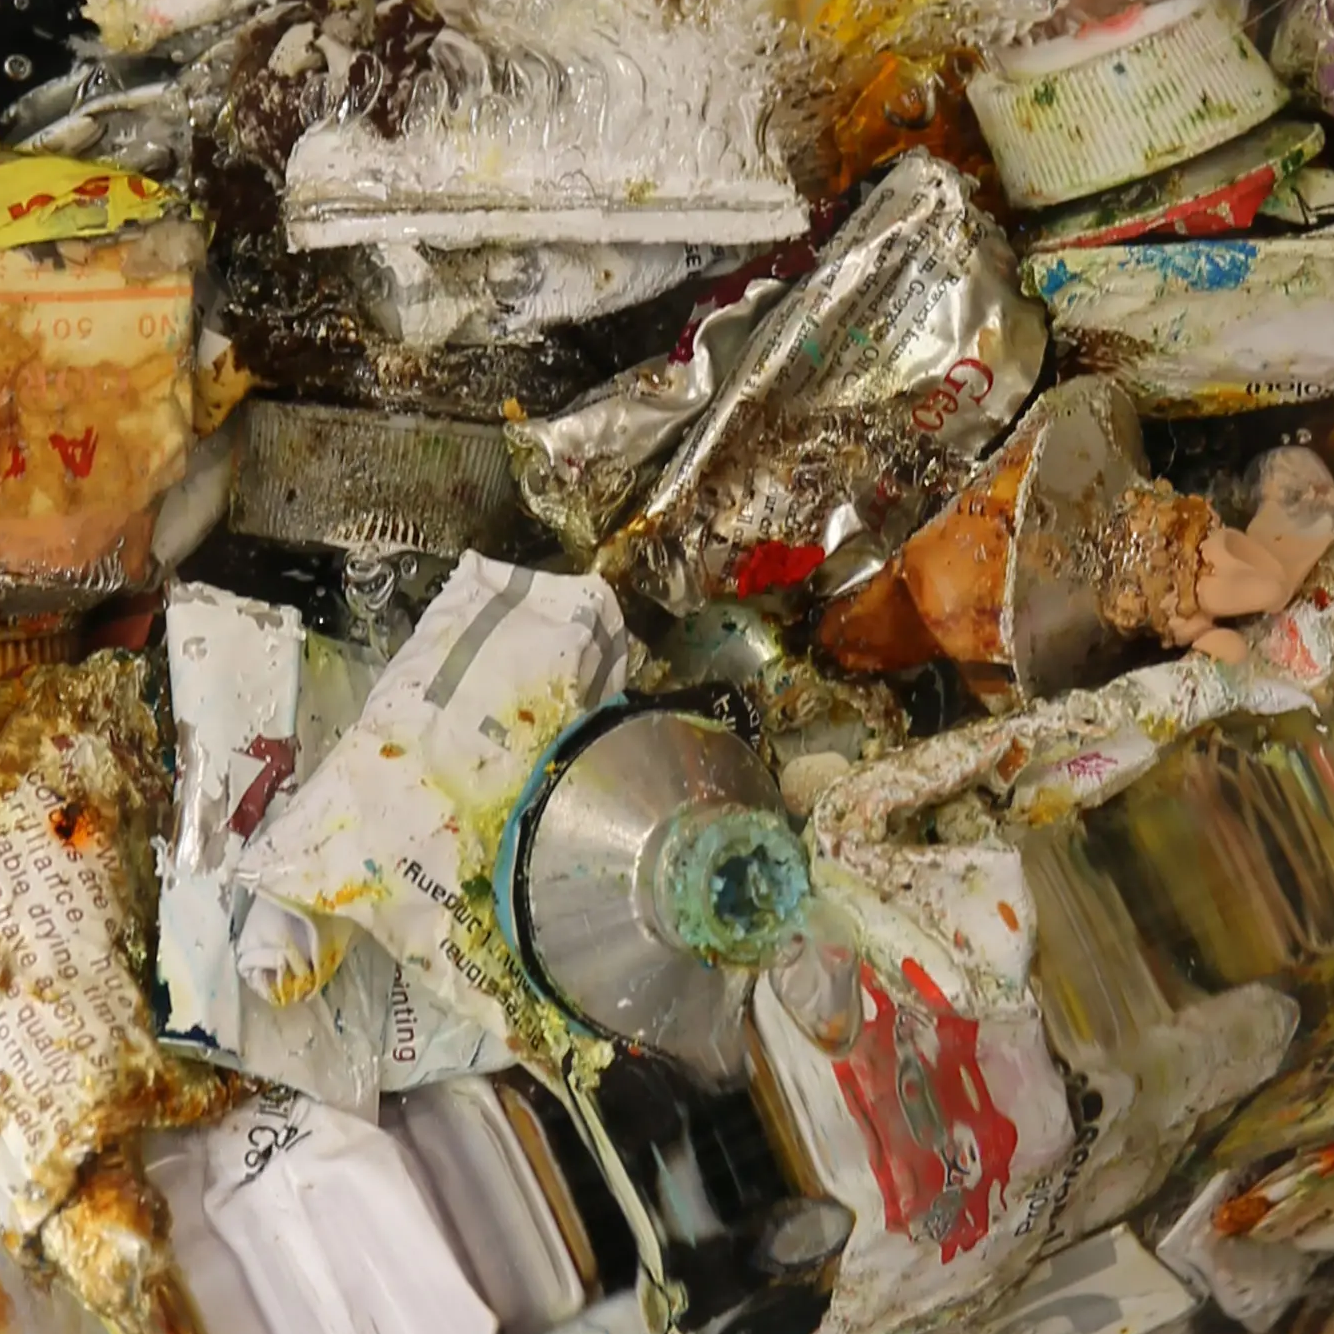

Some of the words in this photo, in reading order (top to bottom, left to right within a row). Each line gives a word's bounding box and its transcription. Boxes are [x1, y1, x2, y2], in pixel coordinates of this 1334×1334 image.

[76, 865, 109, 911] are
[28, 900, 81, 982] drying
[14, 1003, 77, 1089] quality
